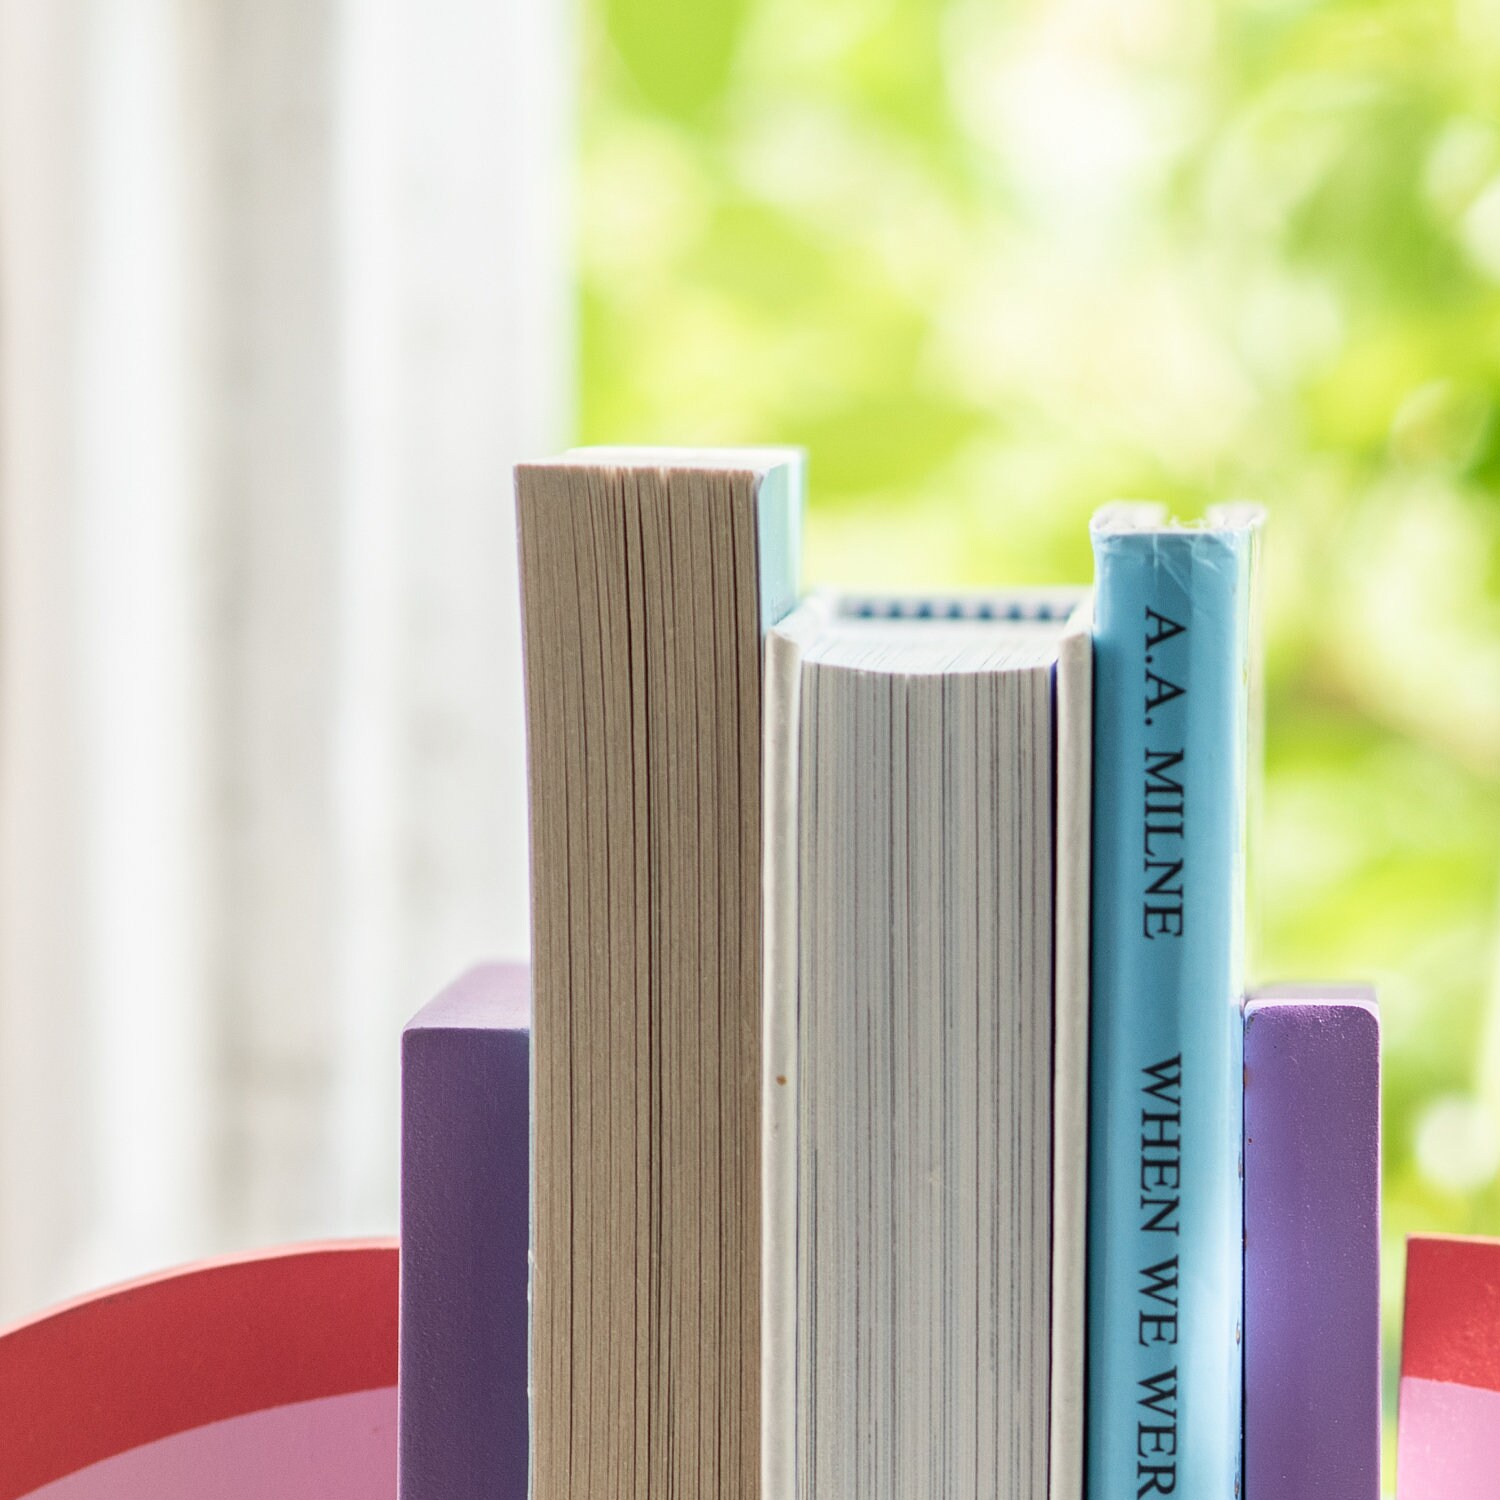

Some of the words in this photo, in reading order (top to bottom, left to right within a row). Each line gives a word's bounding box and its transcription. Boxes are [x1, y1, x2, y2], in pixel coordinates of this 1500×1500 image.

[1144, 605, 1188, 728] A.A.
[1142, 747, 1185, 941] MILNE
[1139, 1051, 1182, 1237] WHEN
[1137, 1253, 1179, 1348] WE
